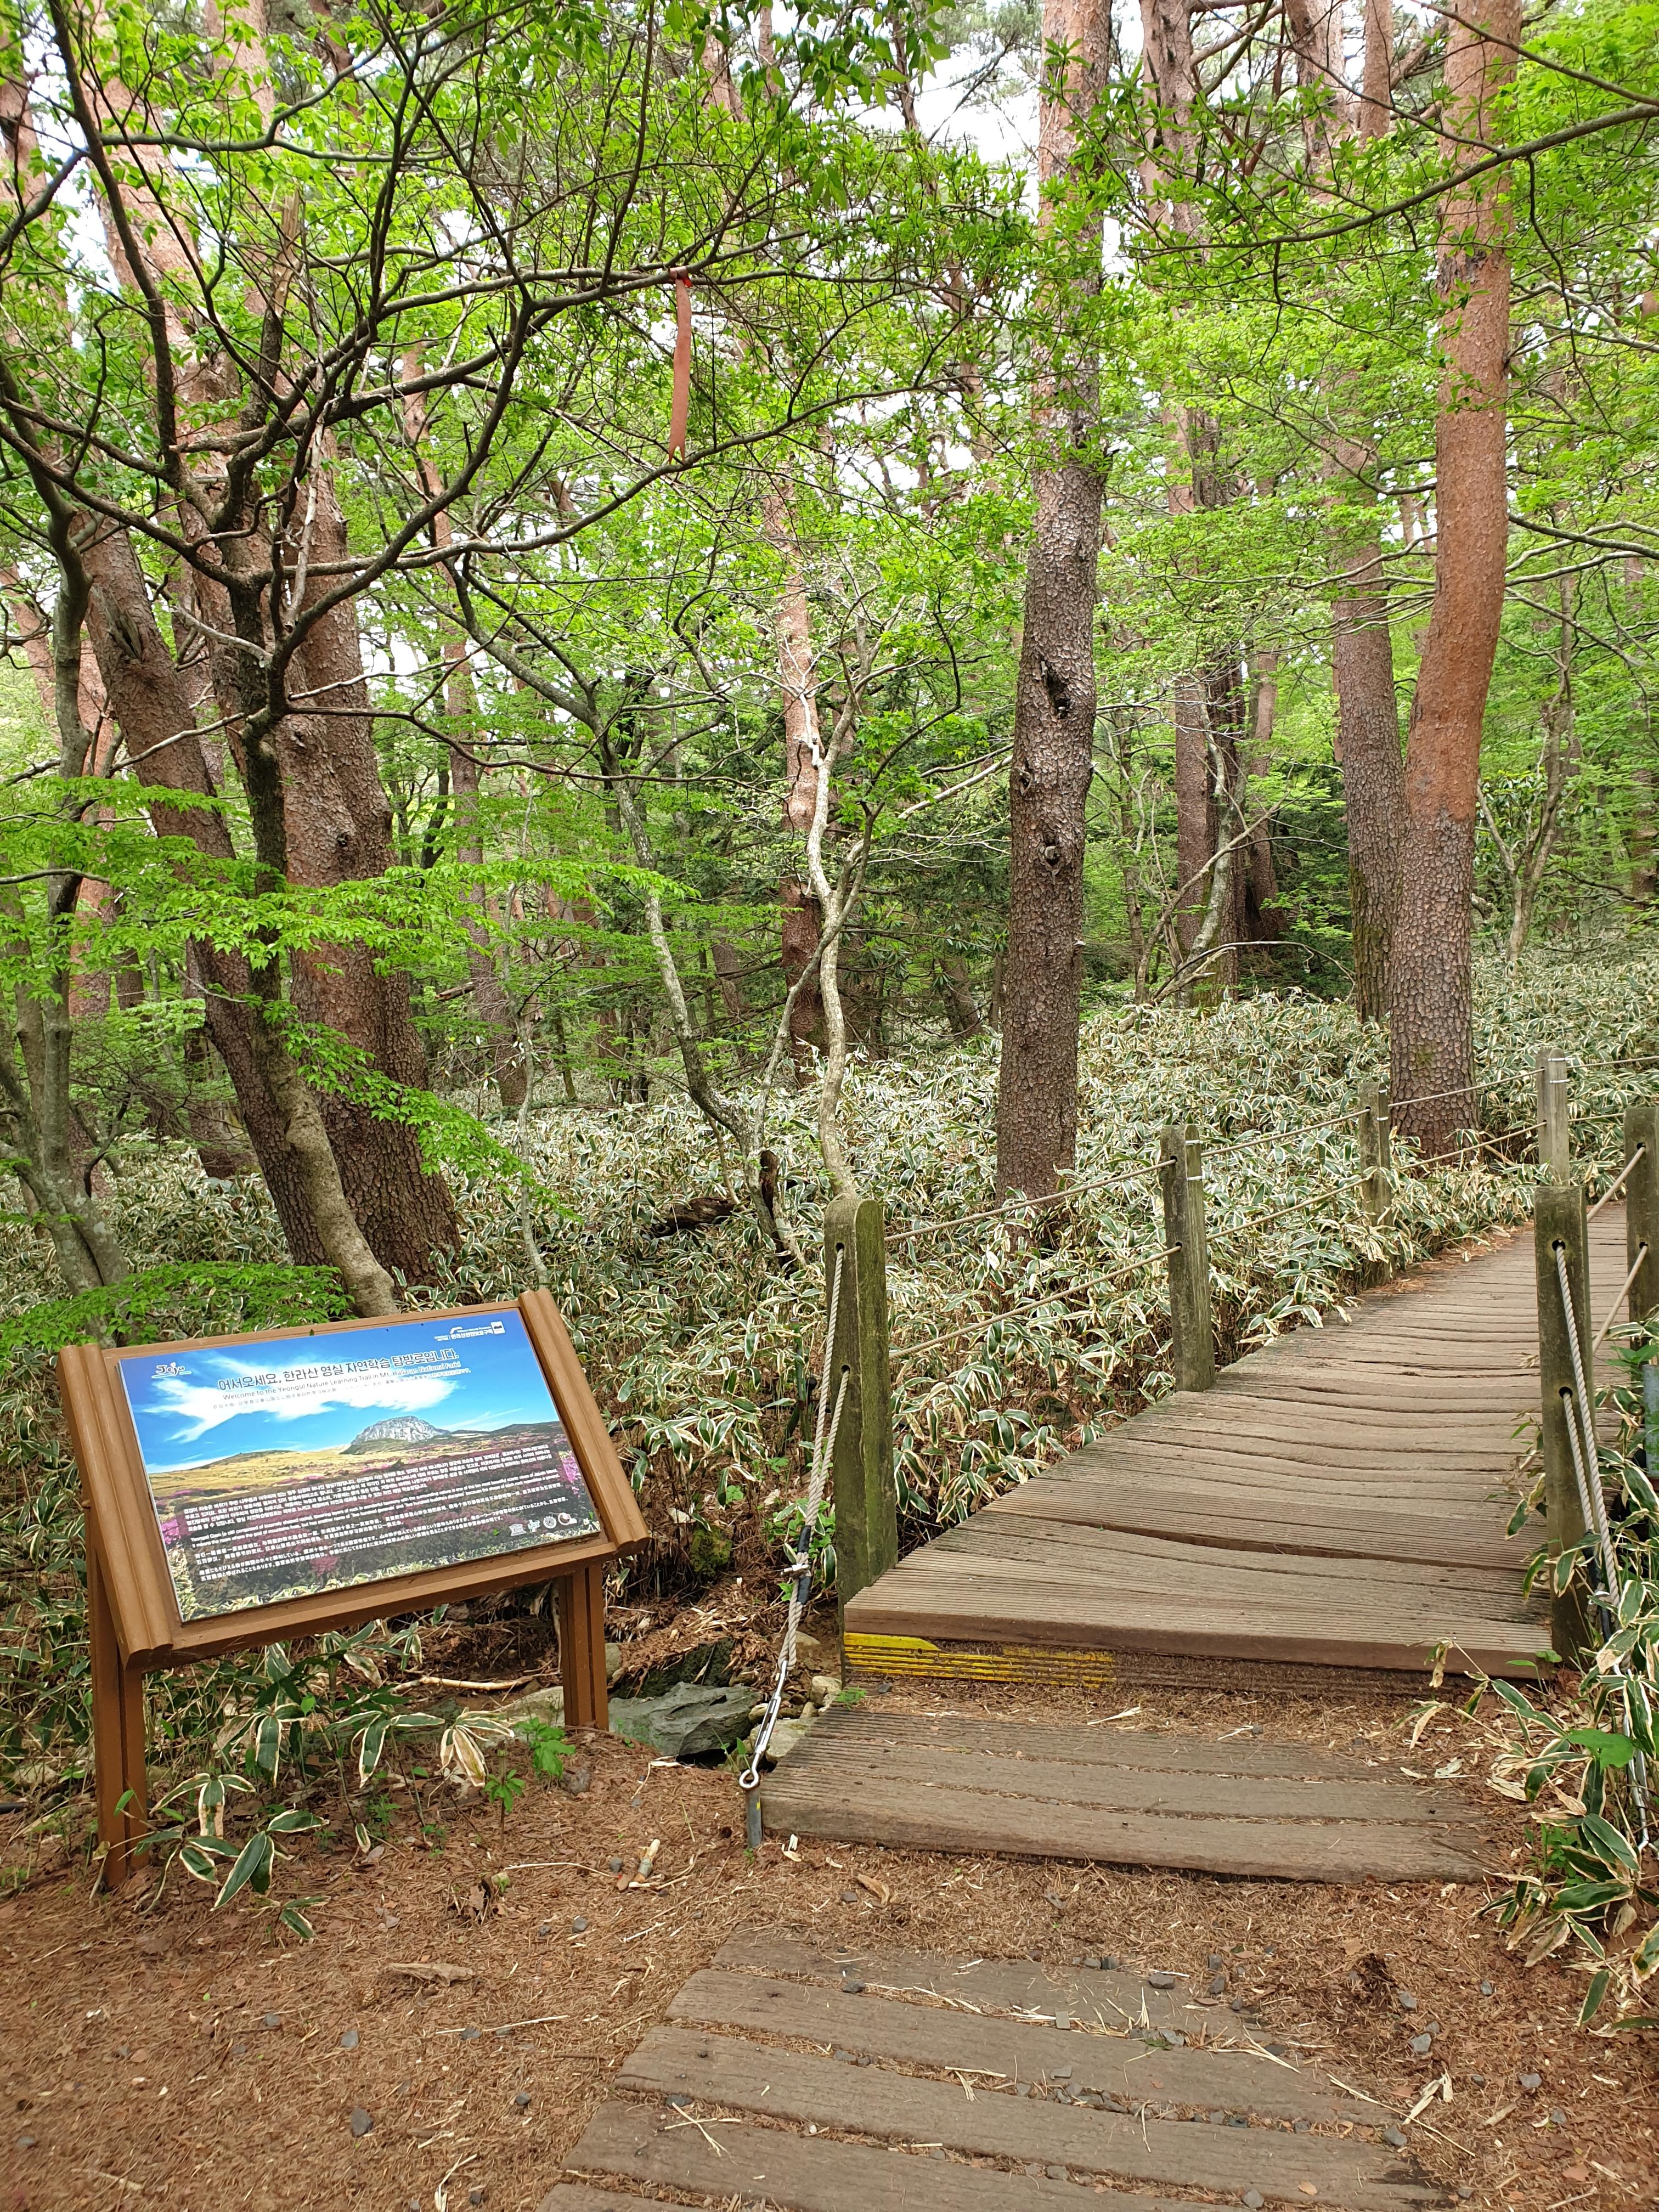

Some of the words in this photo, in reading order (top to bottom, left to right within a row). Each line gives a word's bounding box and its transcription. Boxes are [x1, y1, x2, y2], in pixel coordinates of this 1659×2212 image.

[156, 1362, 187, 1378] Jeju
[217, 1372, 282, 1391] 어서오세요,
[282, 1367, 320, 1382] 한라산
[320, 1364, 345, 1377] 영실
[345, 1357, 391, 1373] 자연학습
[391, 1348, 459, 1367] 탐방로입니다.
[222, 1390, 256, 1400] Welcome
[276, 1383, 306, 1393] Yeongsil
[329, 1376, 358, 1386] Learning
[391, 1367, 420, 1376] Hallasan
[417, 1363, 445, 1373] National
